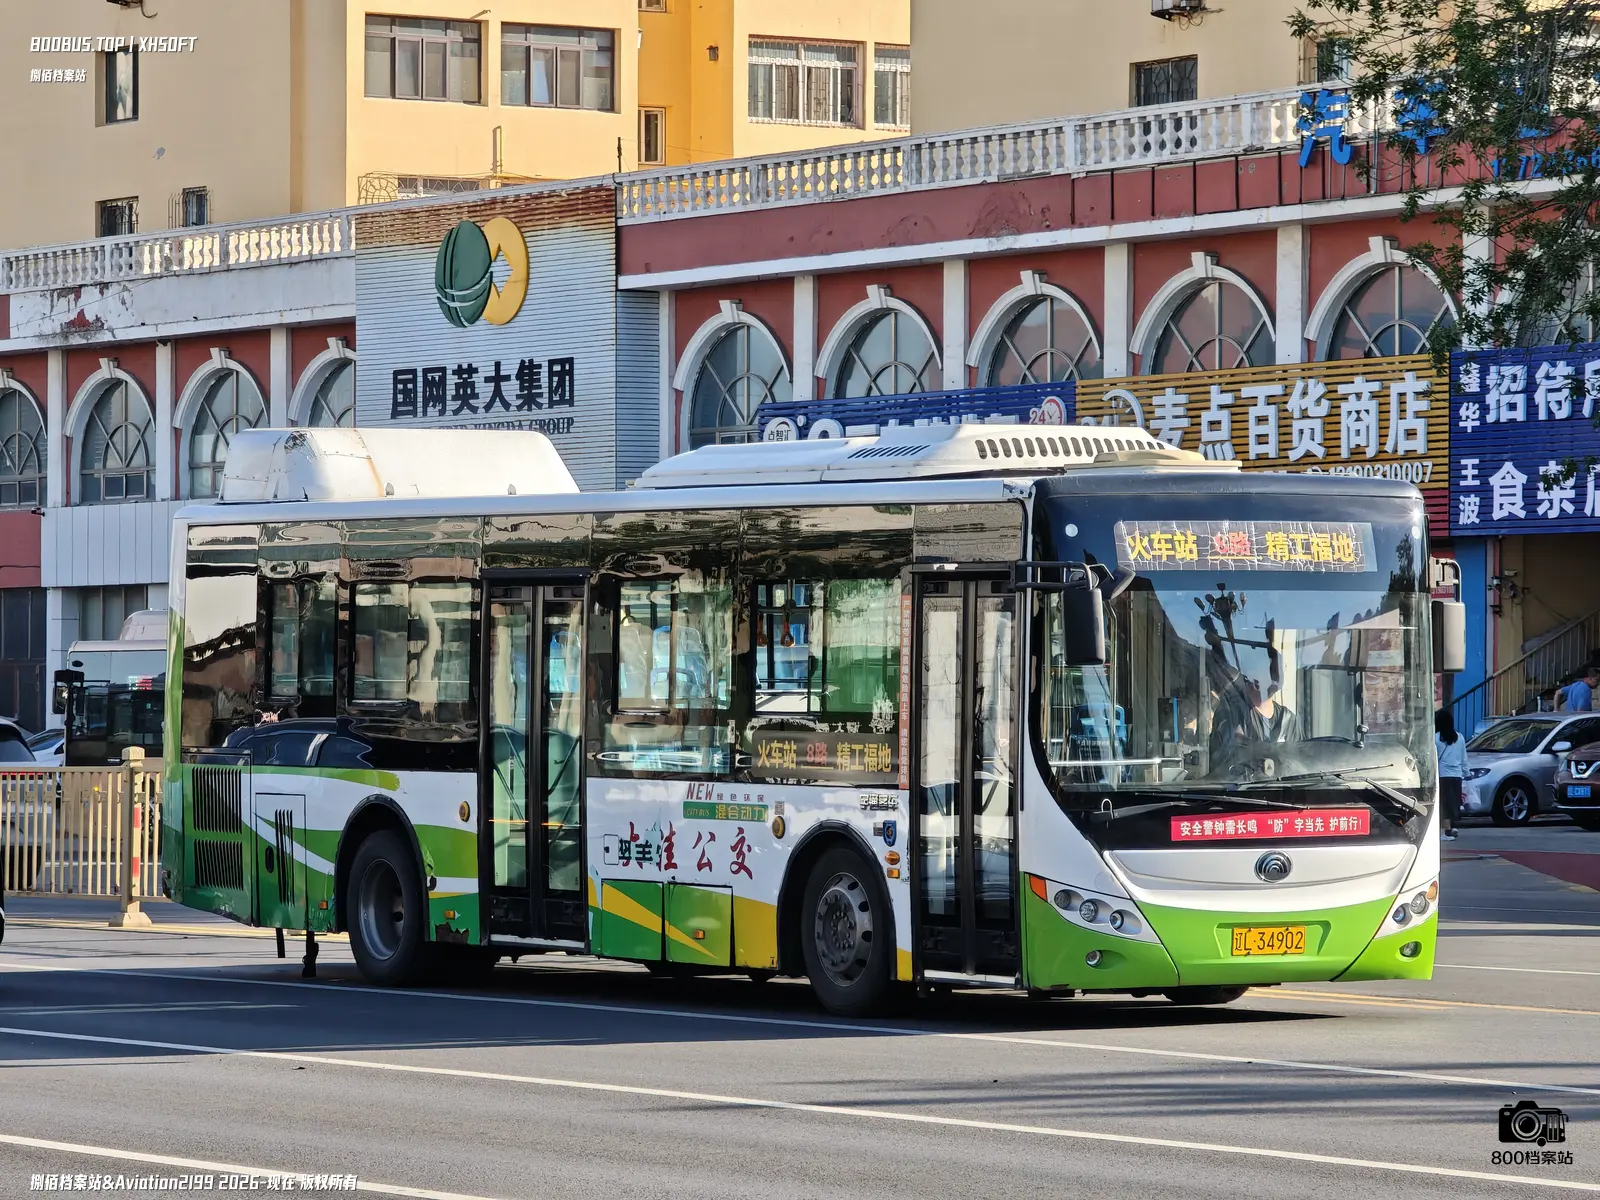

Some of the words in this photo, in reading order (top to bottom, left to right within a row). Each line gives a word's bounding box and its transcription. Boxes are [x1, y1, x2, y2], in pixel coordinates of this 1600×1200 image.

[390, 356, 575, 419] 国网英大集团
[529, 416, 575, 435] GROUP
[1150, 371, 1432, 462] 麦点百货商店
[1459, 458, 1481, 525] 王波
[1127, 530, 1199, 562] 火车站
[1214, 531, 1252, 557] 8路
[1265, 530, 1354, 562] 精工福地
[757, 739, 797, 770] 火车站
[806, 742, 828, 767] 8路
[836, 741, 892, 773] 精工福地
[686, 782, 715, 801] NEW
[715, 803, 768, 821] 混合动力
[1180, 819, 1258, 837] 安全警钟需长鸣
